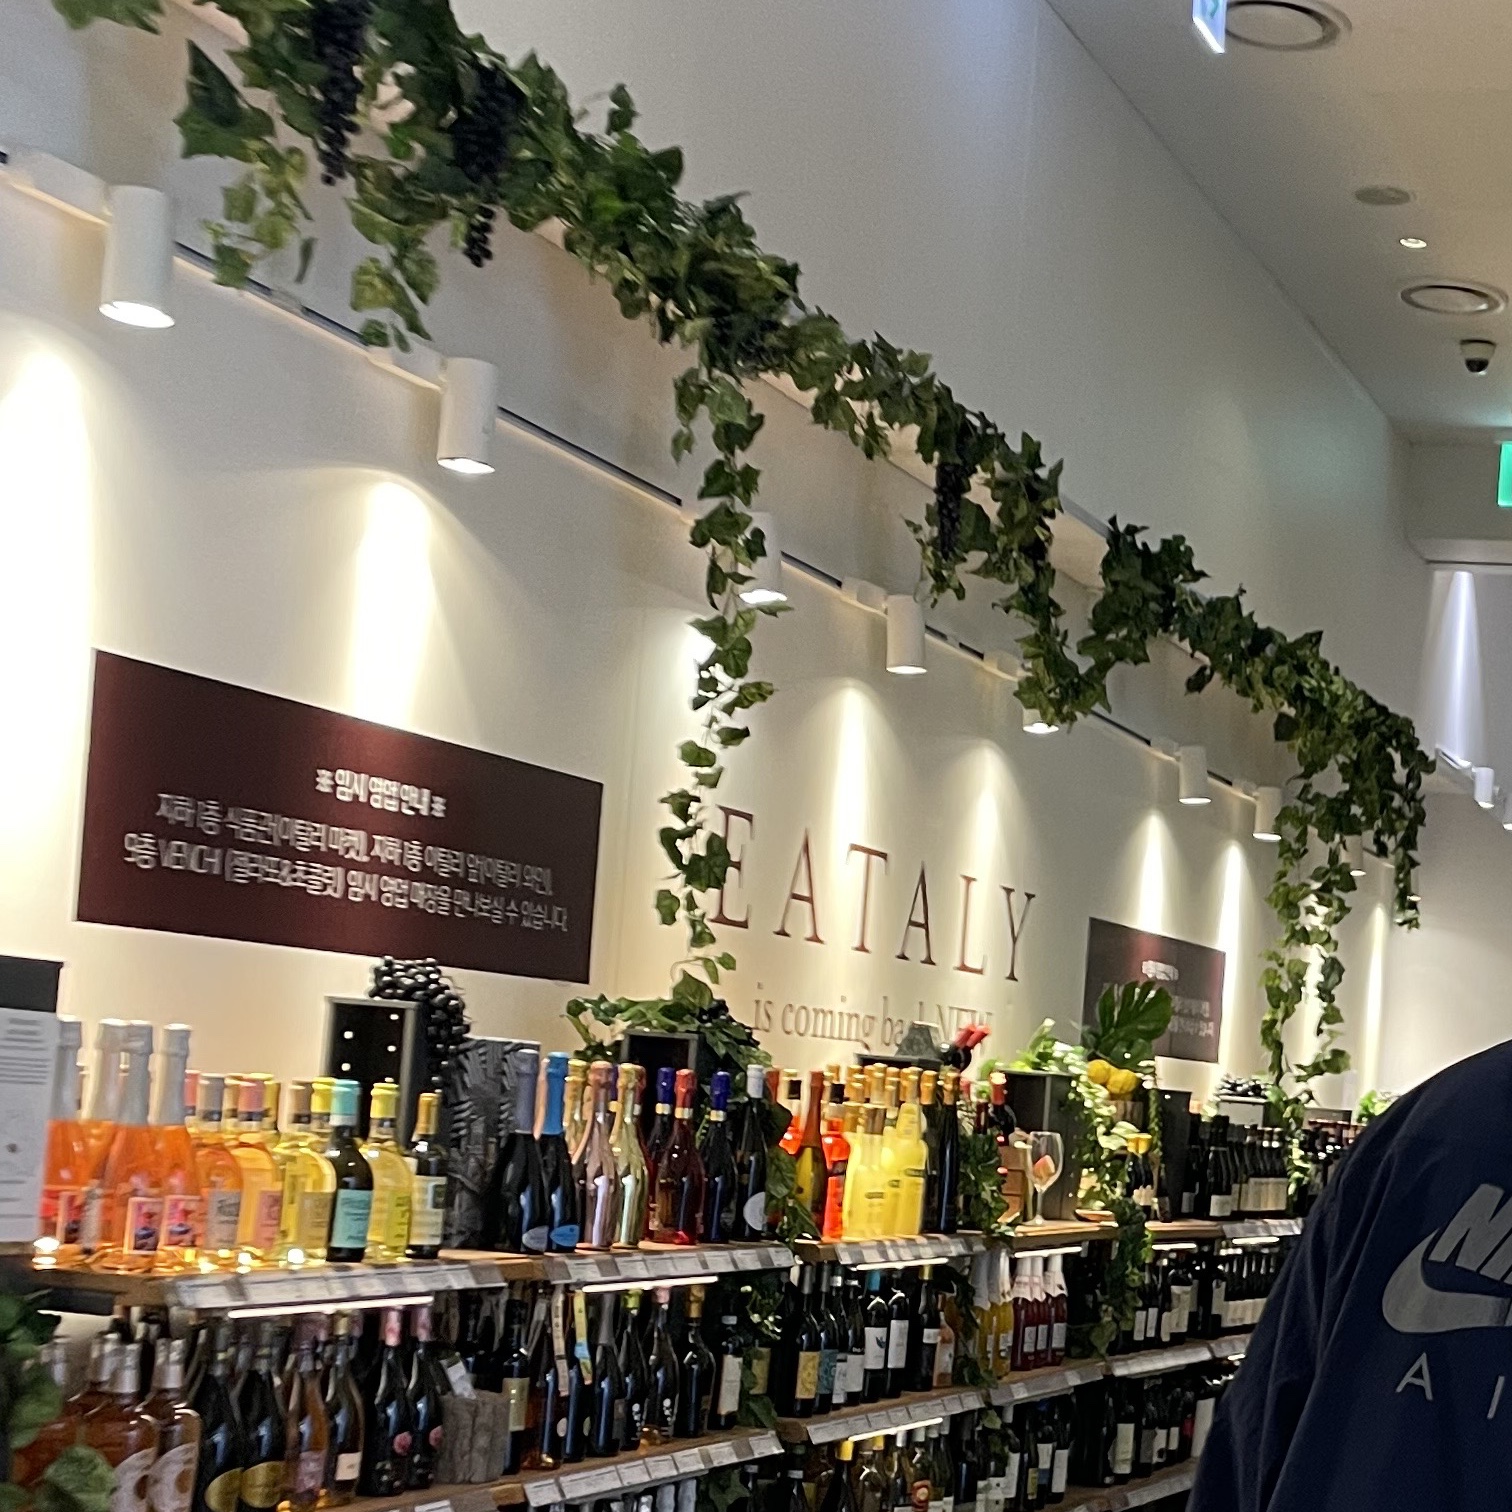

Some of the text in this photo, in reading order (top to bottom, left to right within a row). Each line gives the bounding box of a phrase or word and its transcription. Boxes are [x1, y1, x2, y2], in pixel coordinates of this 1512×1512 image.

[709, 804, 1036, 982] EATALY
[754, 982, 774, 1032] is
[781, 995, 878, 1052] coming
